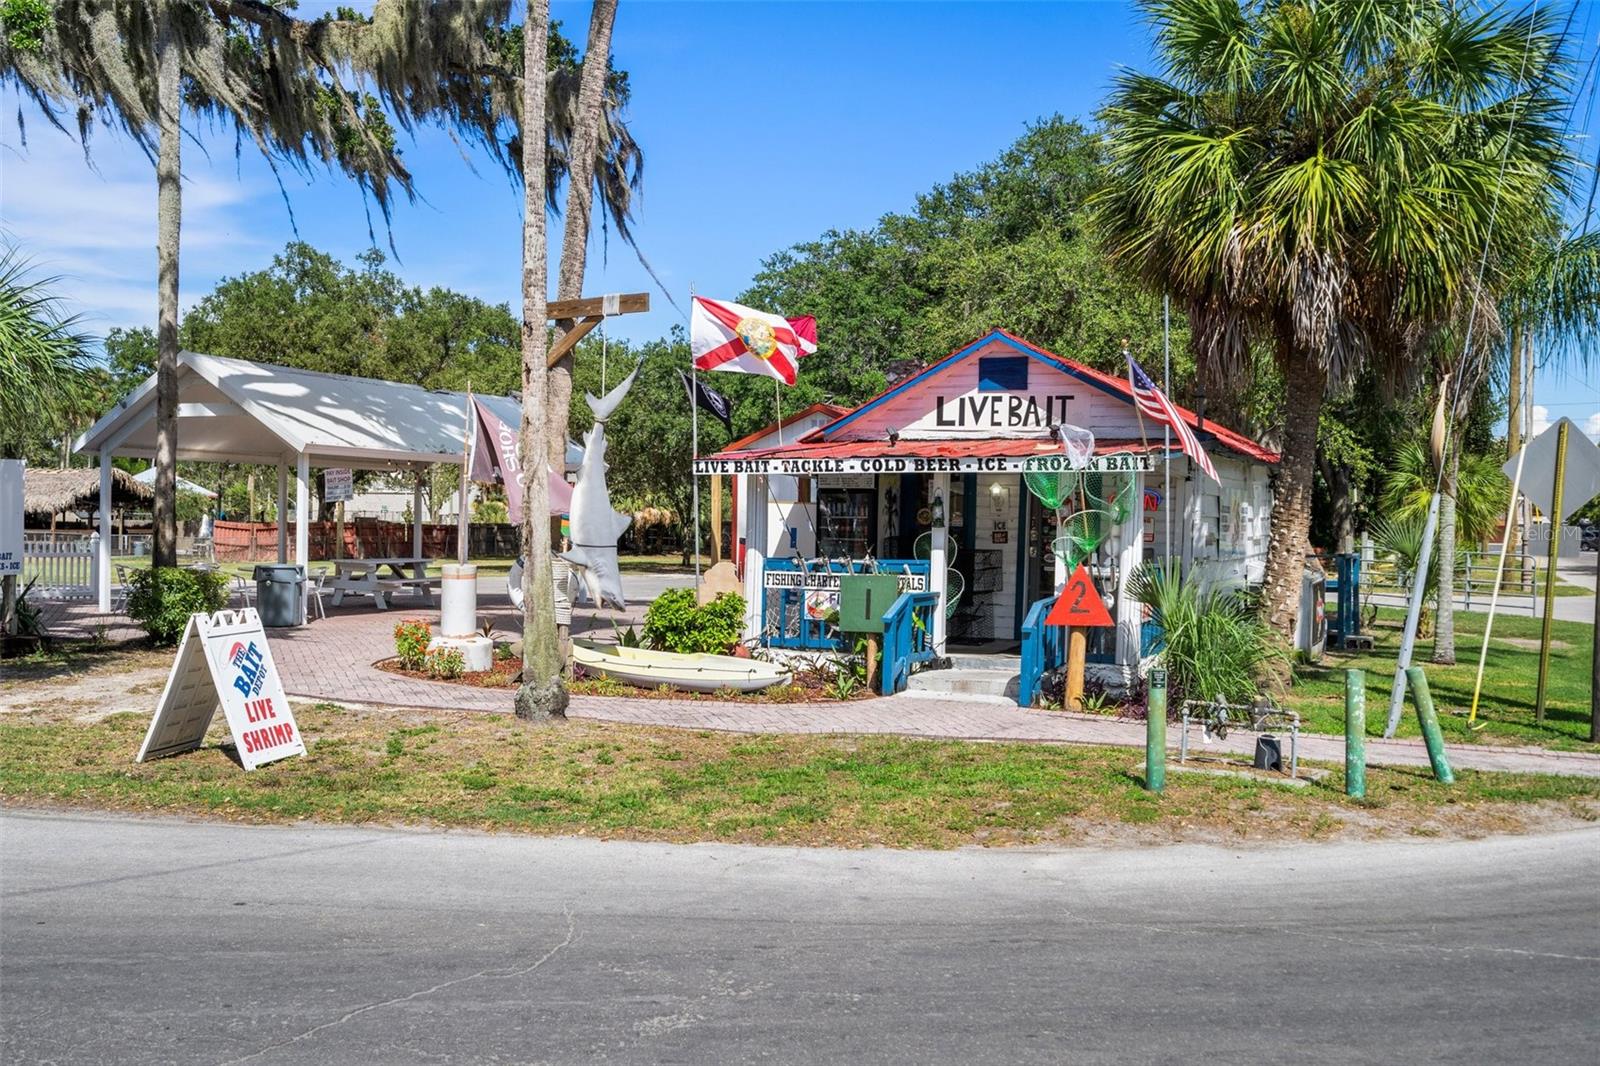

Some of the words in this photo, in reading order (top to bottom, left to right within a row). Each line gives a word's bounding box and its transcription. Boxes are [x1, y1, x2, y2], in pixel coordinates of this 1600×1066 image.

[936, 395, 1003, 427] LIVE
[1008, 395, 1075, 427] BAIT
[694, 460, 729, 473] LIVE
[733, 460, 770, 473] BAIT
[781, 459, 844, 473] TACKLE
[860, 459, 906, 472] COLD
[913, 458, 961, 471] BEER
[977, 458, 1007, 471] ICE
[1025, 458, 1099, 471] FROZN
[1106, 457, 1151, 470] BAIT
[766, 573, 802, 587] FISHING
[804, 574, 841, 588] CHARTE
[1070, 580, 1090, 613] 2
[232, 647, 247, 669] THE
[233, 640, 264, 698] BAIT
[252, 663, 268, 697] DEPOT
[244, 698, 277, 723] LIVE
[242, 722, 294, 754] SHRIMP
